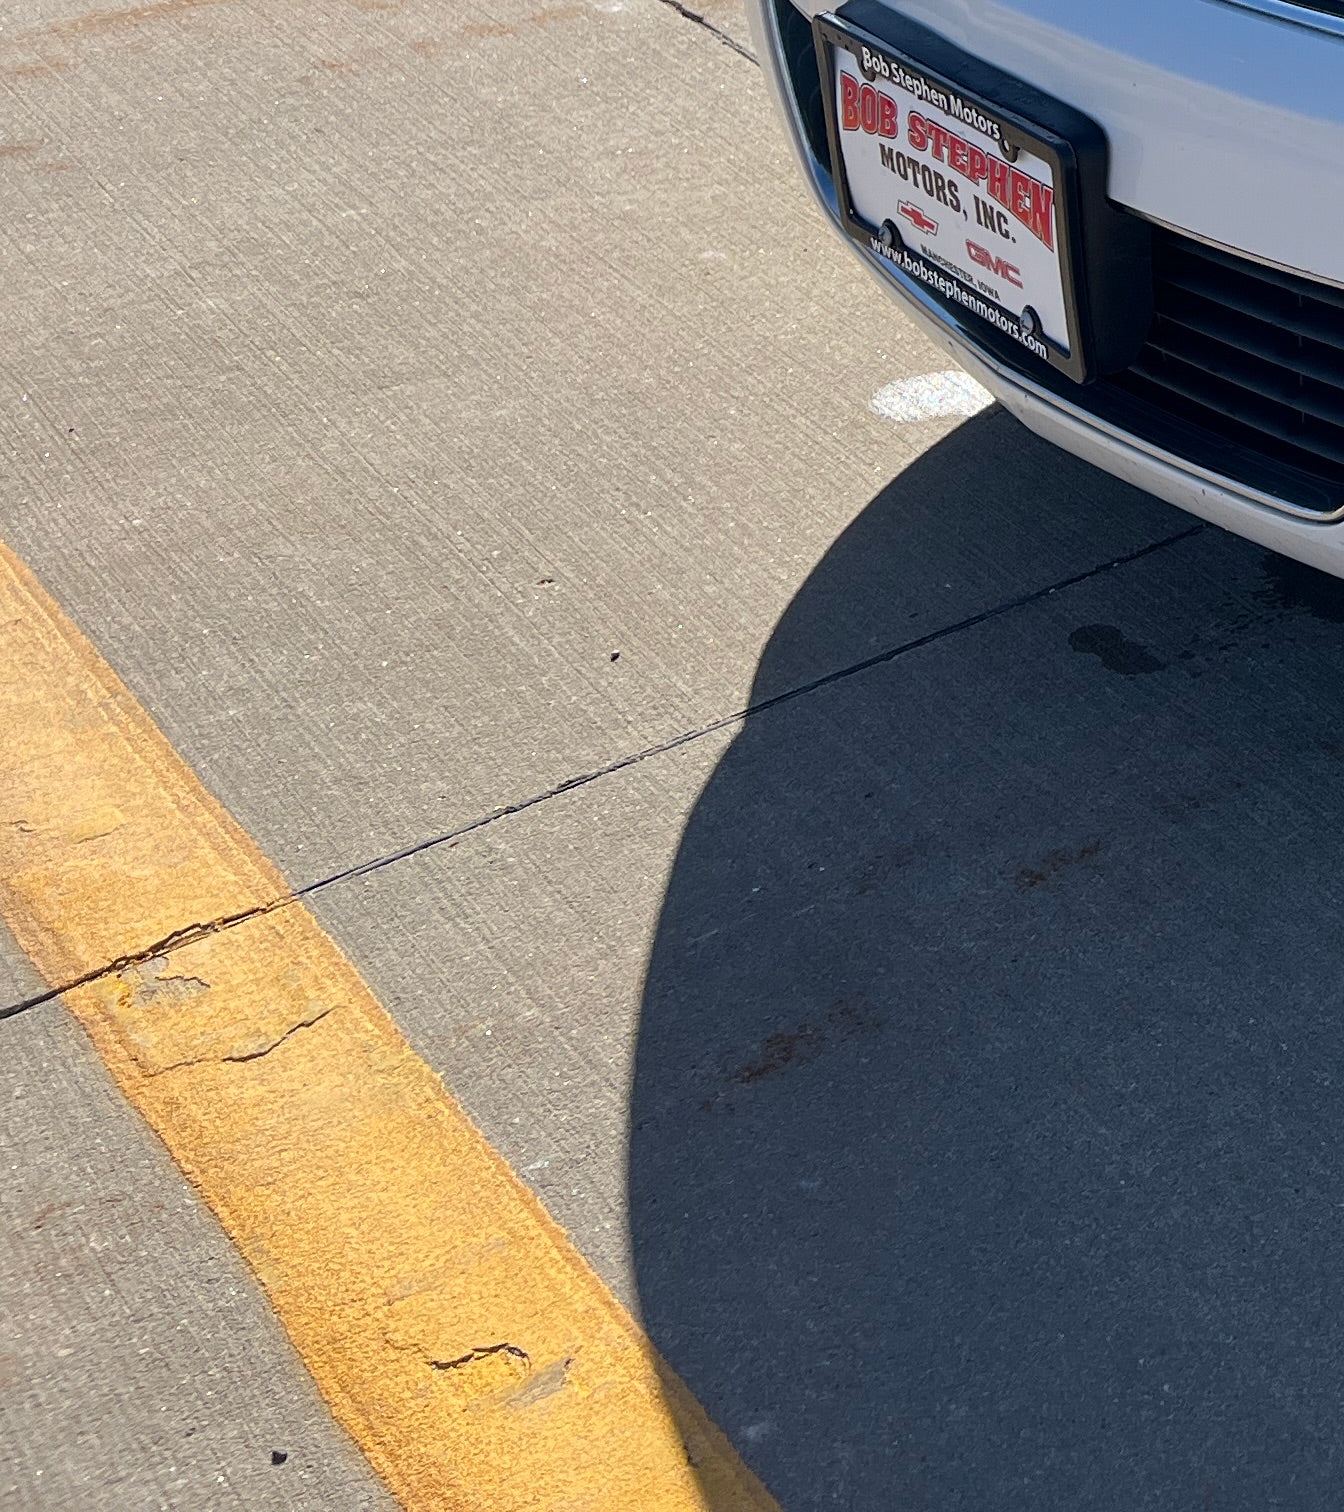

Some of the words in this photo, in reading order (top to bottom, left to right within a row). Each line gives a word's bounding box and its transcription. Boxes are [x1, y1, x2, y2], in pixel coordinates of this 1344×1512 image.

[861, 46, 890, 78] Bob
[892, 62, 948, 111] Stephen
[949, 94, 1001, 140] Motors
[840, 69, 899, 140] BOB
[907, 110, 1055, 253] STEPHEN
[878, 142, 968, 222] MOTORS,
[973, 194, 1017, 244] INC.
[869, 235, 1049, 360] www.bobstephenmotors.com
[965, 238, 1025, 290] GMC
